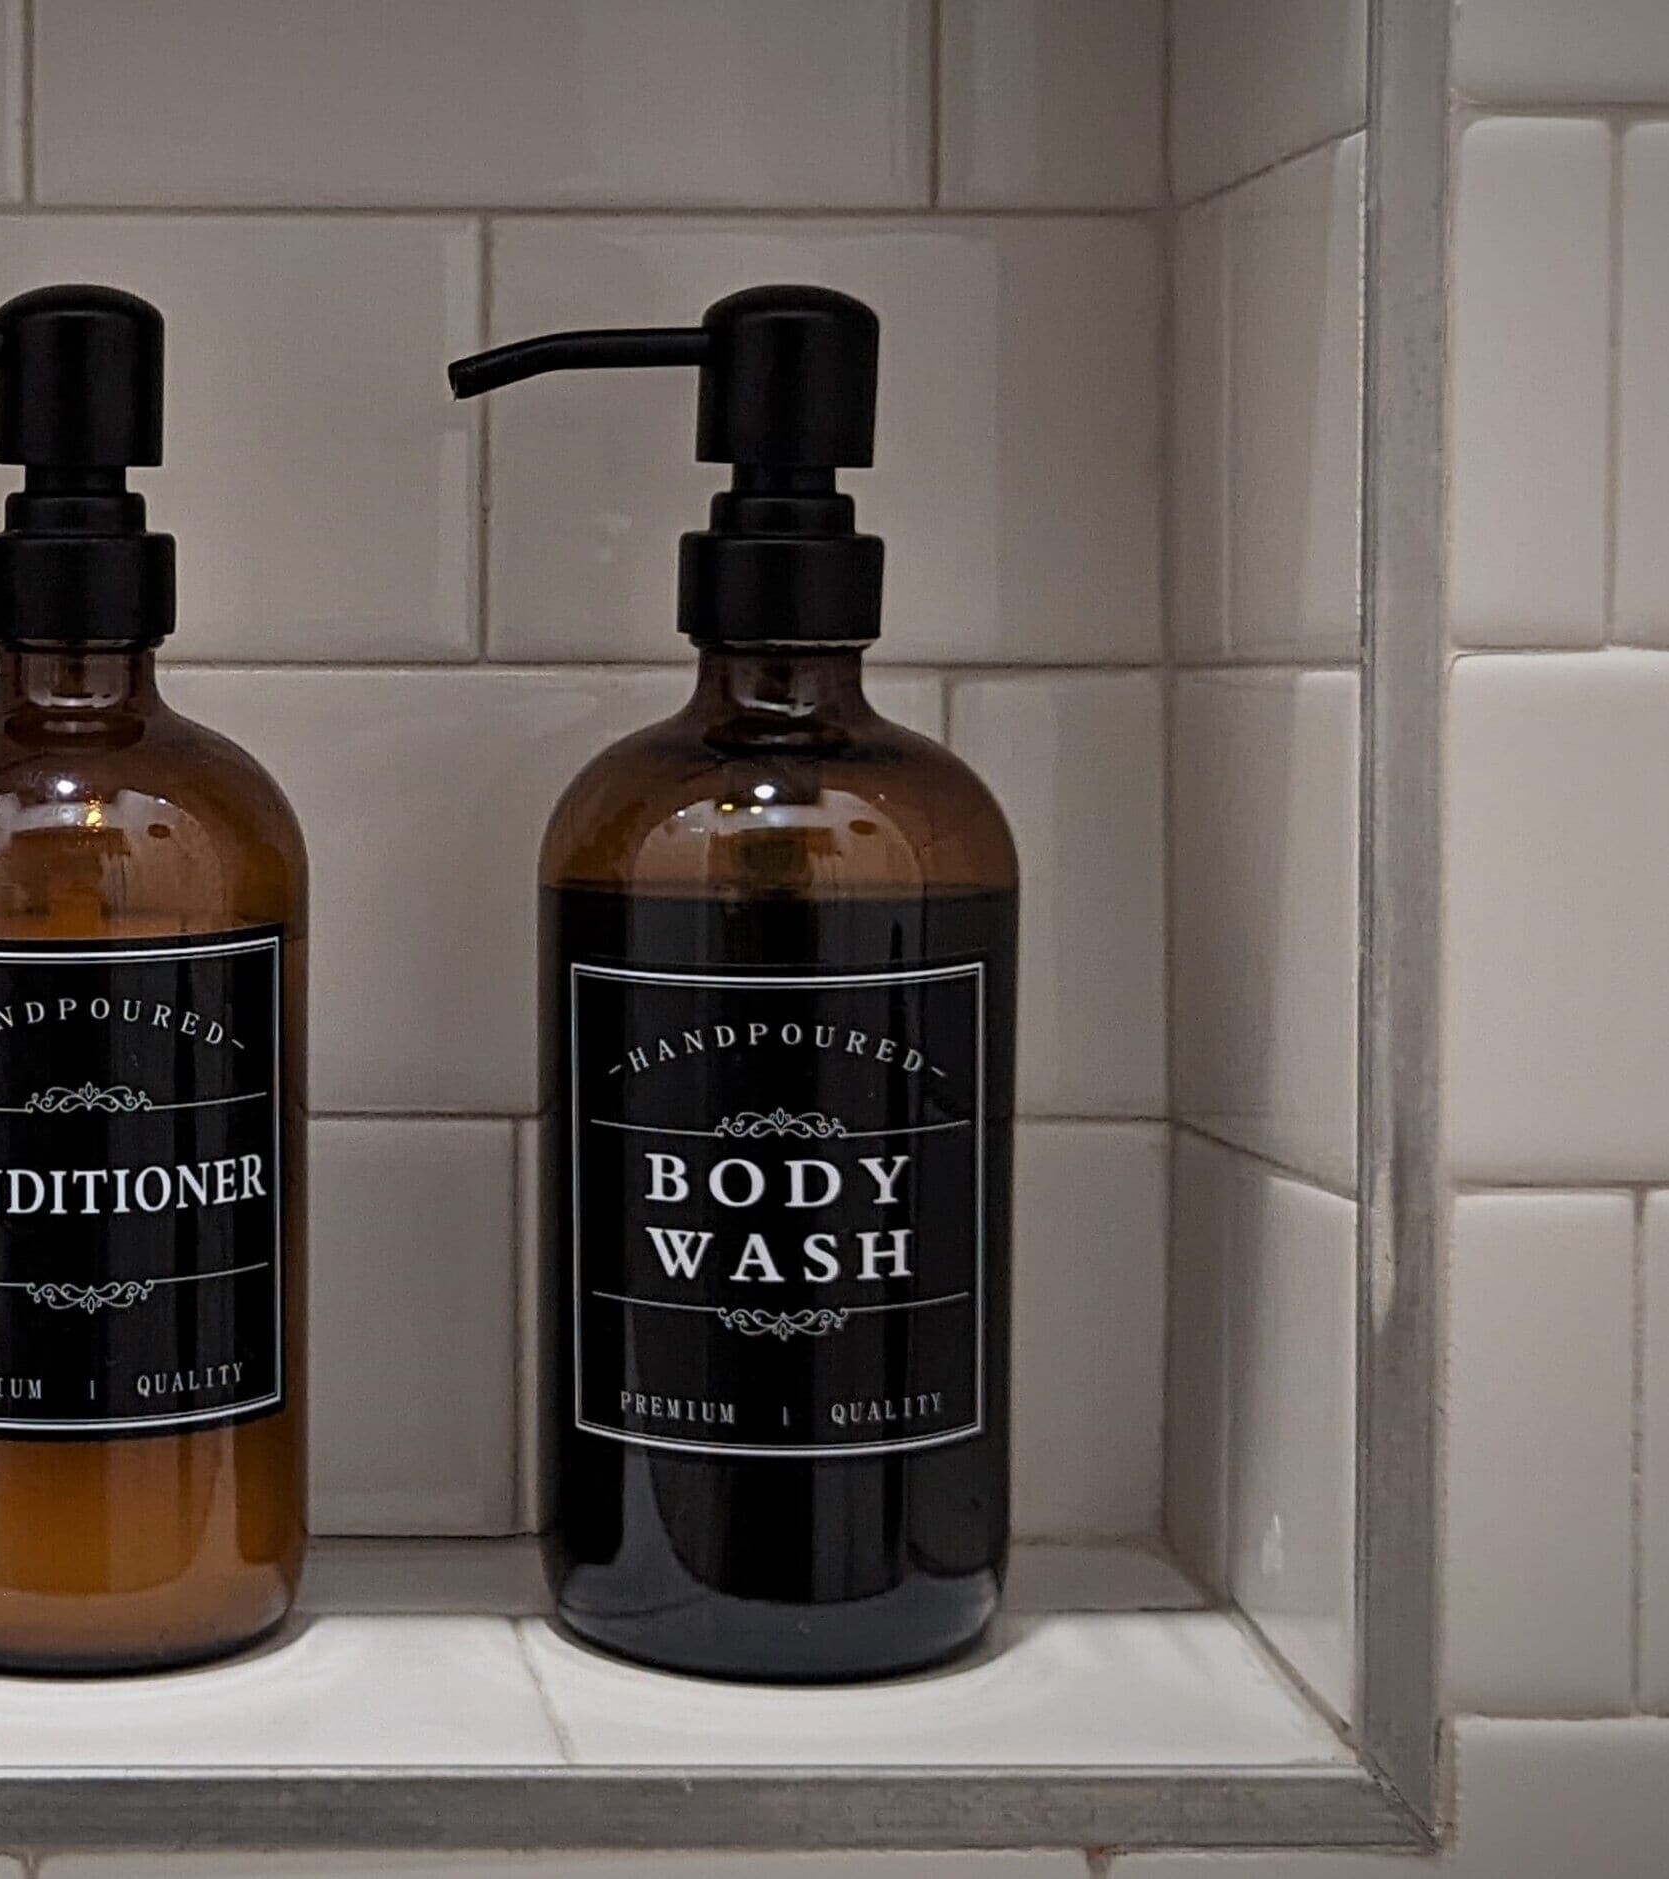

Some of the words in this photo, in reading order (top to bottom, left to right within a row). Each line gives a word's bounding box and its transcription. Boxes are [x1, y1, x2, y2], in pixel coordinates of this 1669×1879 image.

[644, 1153, 910, 1208] BODY
[644, 1226, 912, 1283] WASH
[137, 1362, 244, 1397] QUALITY
[621, 1391, 734, 1423] PREMIUM
[831, 1392, 942, 1425] QUALITY
